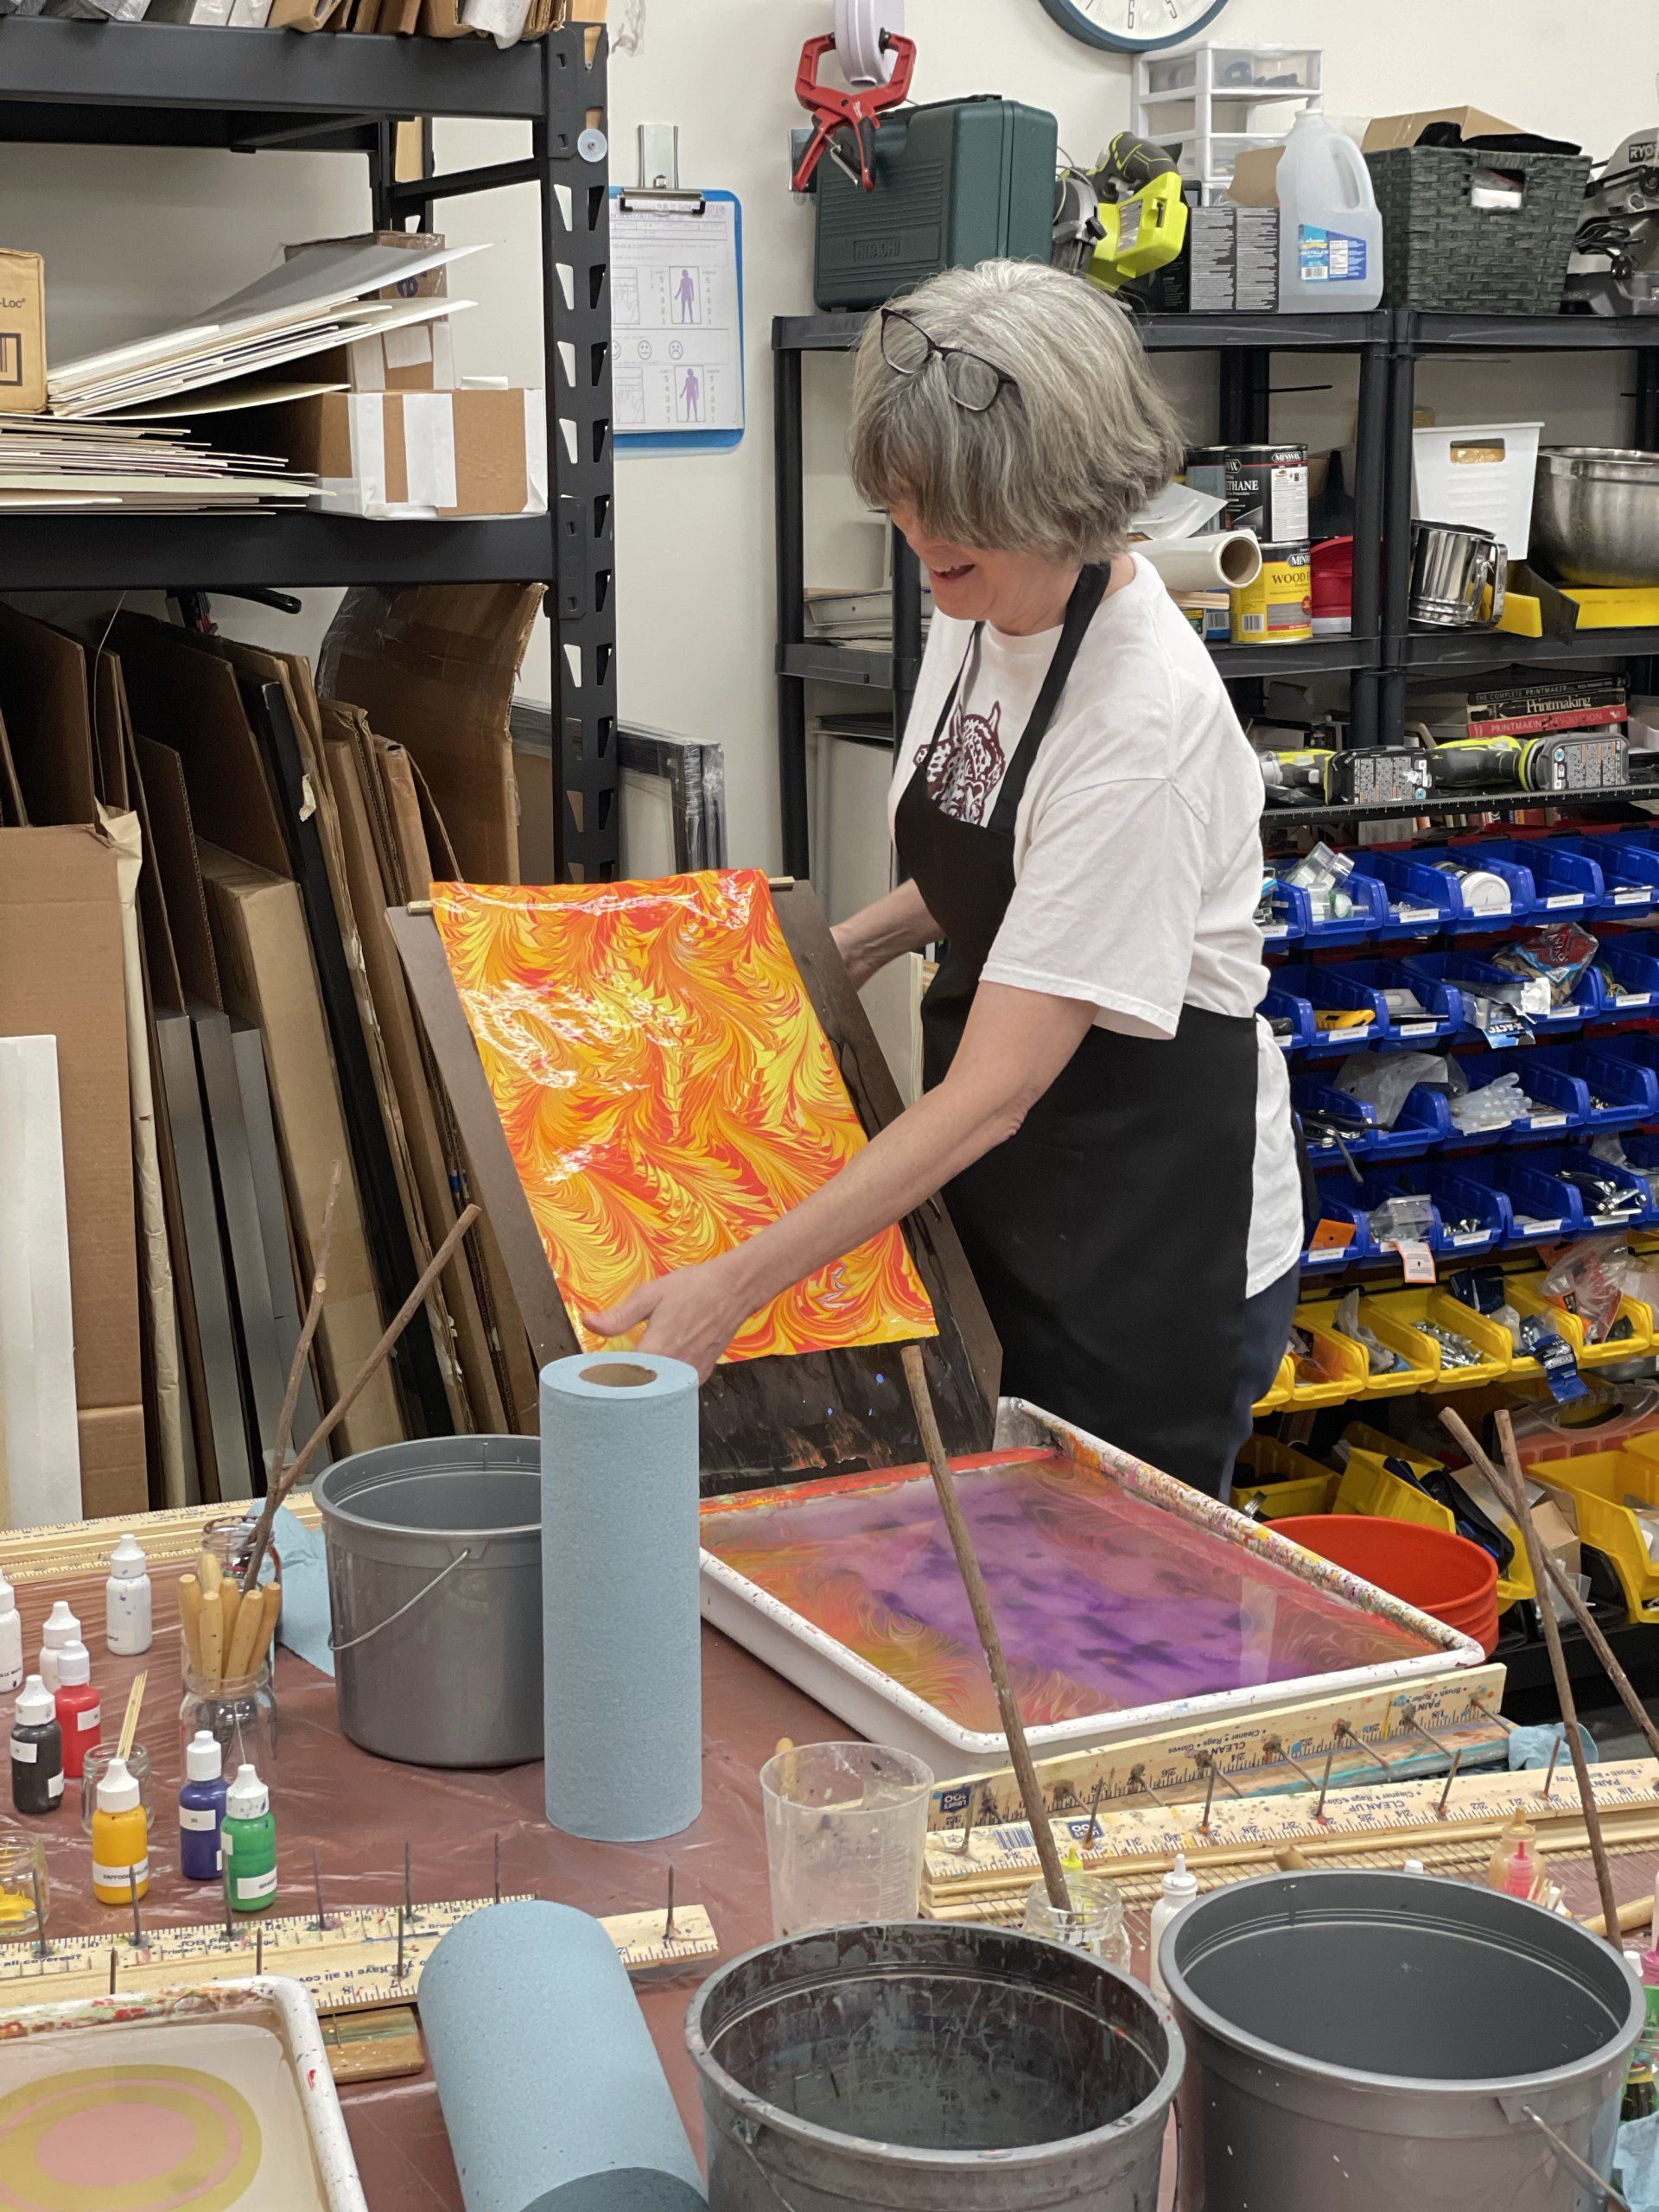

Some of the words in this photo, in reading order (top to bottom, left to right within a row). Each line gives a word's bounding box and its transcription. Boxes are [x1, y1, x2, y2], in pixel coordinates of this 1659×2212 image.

[1630, 143, 1656, 159] RYO
[1274, 452, 1301, 461] MINWAX
[1272, 573, 1306, 585] WOOD
[1491, 690, 1522, 700] COMPLETE
[1525, 685, 1567, 696] PRINTMAKER
[1526, 695, 1592, 714] Printmaking
[1350, 1803, 1368, 1813] UP
[1369, 1801, 1405, 1812] CLEAN
[177, 1939, 207, 1948] JOB
